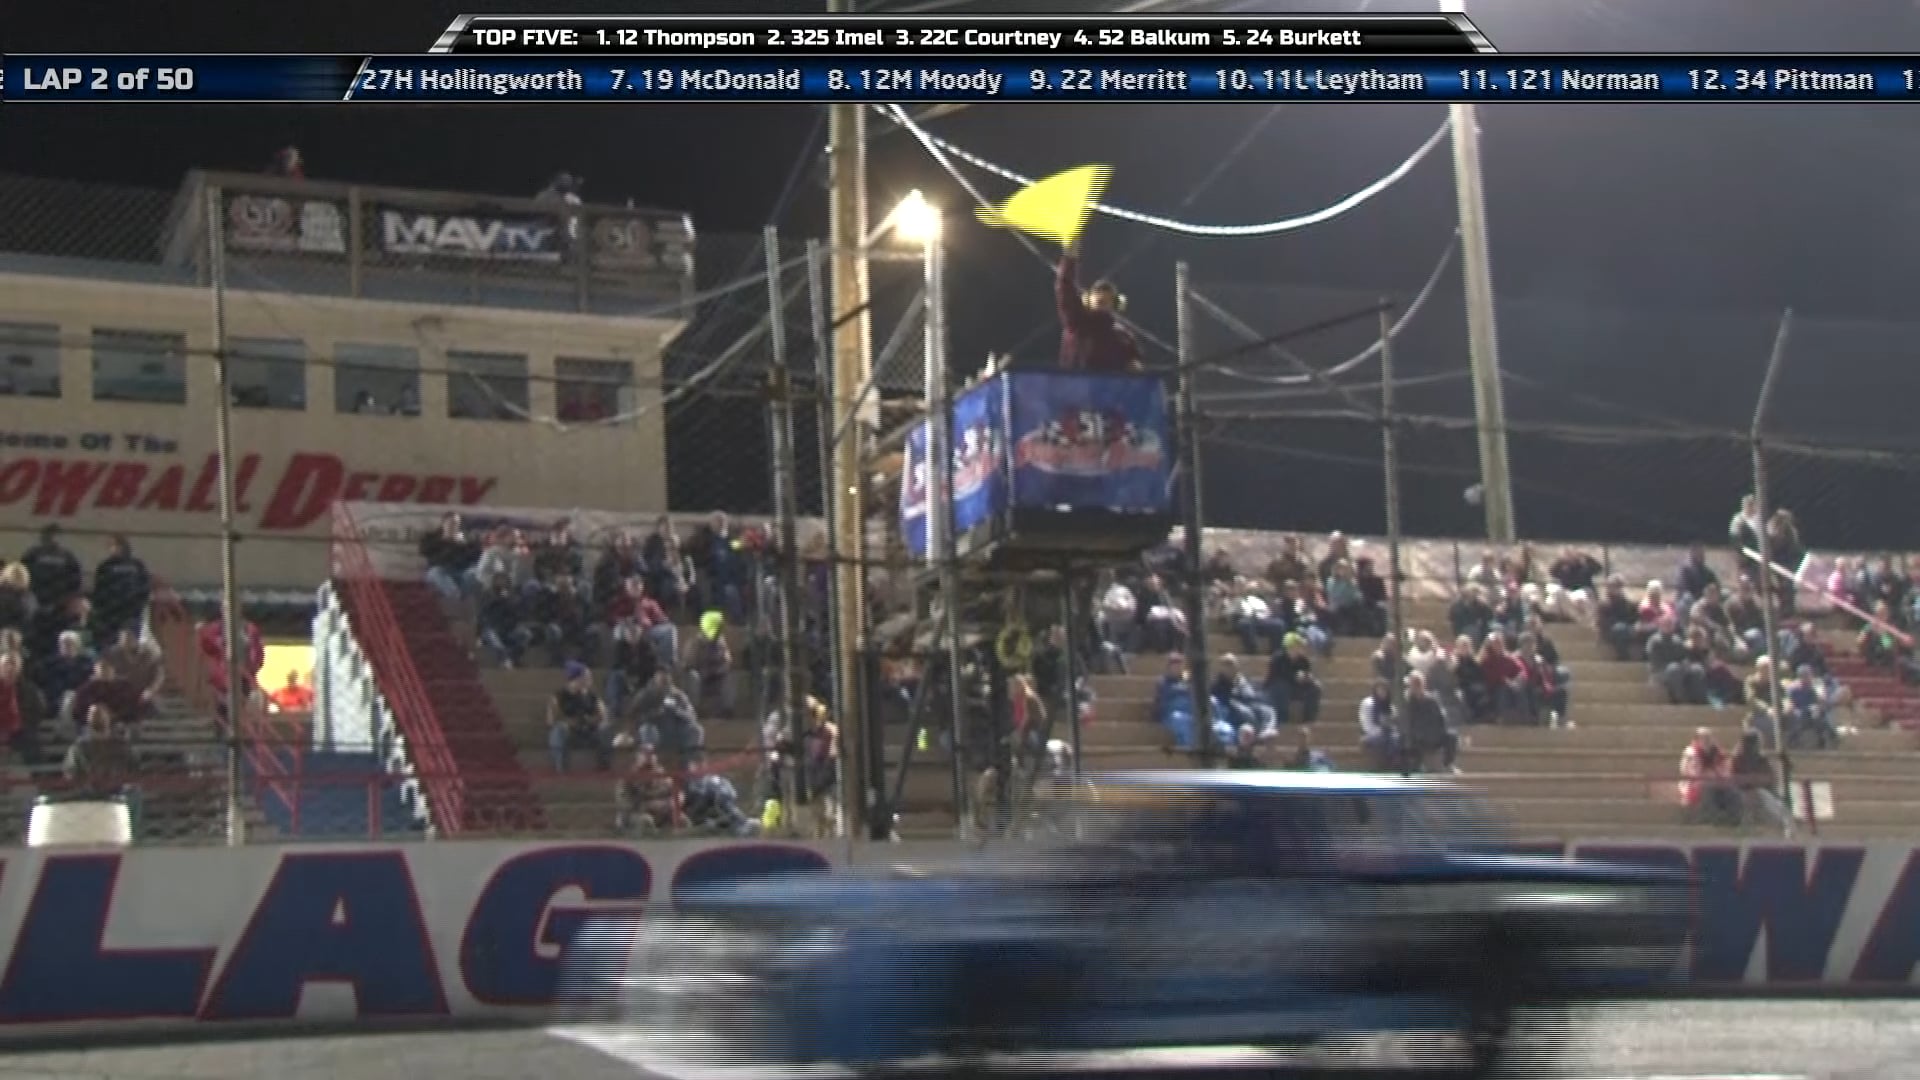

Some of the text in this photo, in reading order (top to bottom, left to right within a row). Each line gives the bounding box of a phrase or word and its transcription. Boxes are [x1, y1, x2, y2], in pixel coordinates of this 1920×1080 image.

[0, 432, 178, 453] ome Of The
